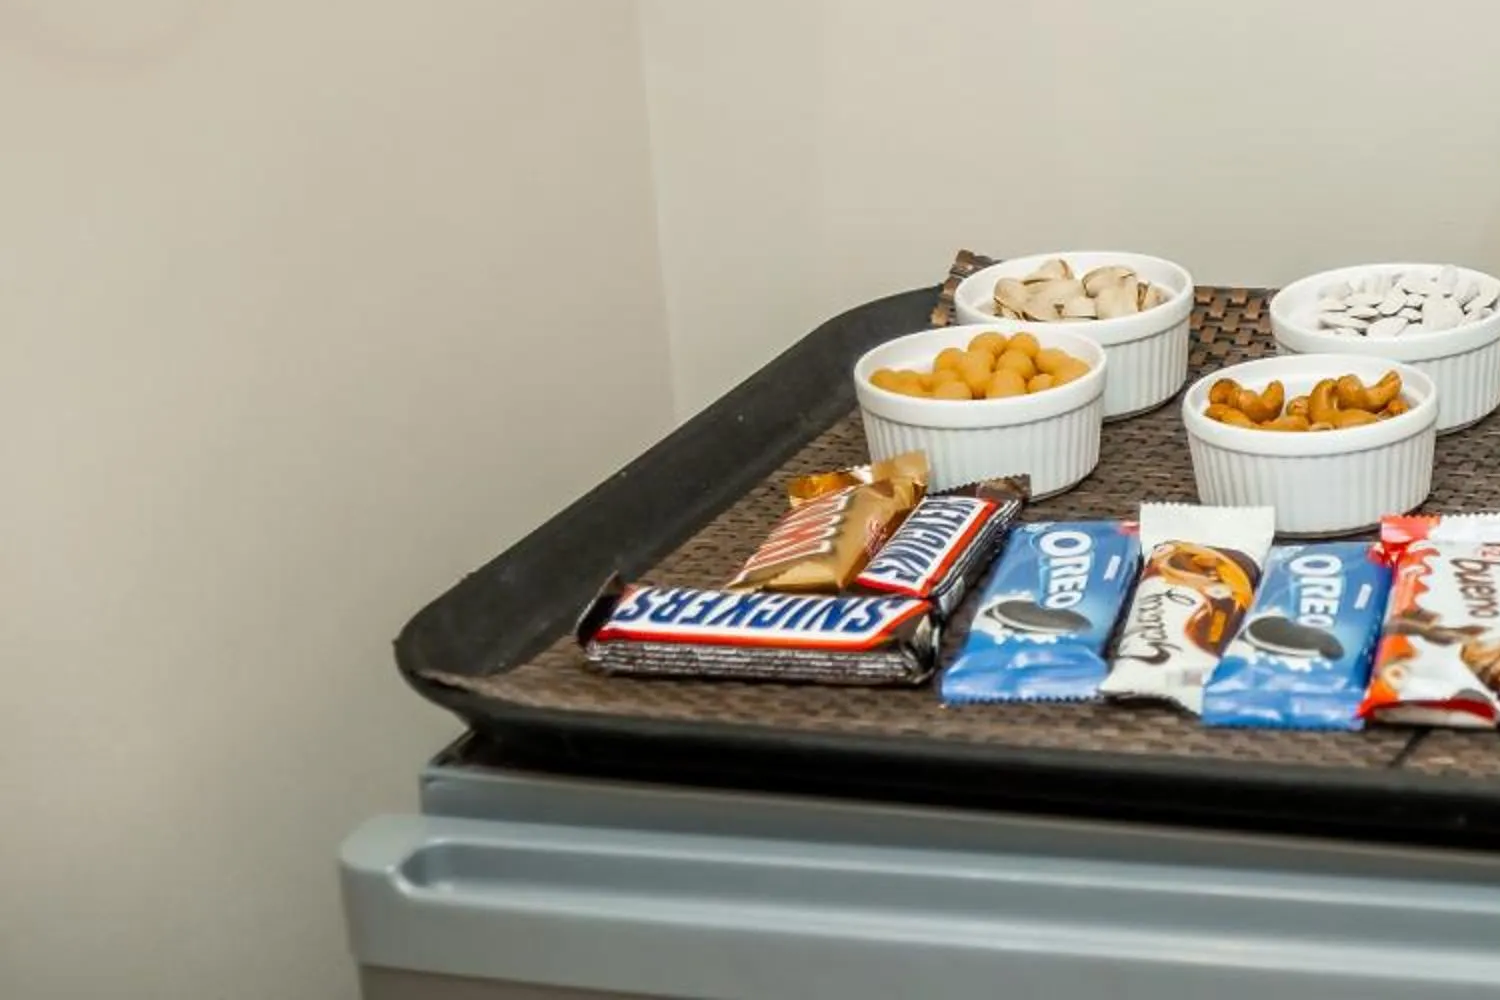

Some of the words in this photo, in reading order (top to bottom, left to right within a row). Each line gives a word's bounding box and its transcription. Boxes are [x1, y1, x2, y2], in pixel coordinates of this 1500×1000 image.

[1038, 530, 1093, 609] OREO
[1288, 554, 1343, 629] OREO
[614, 584, 902, 634] SNICKERS
